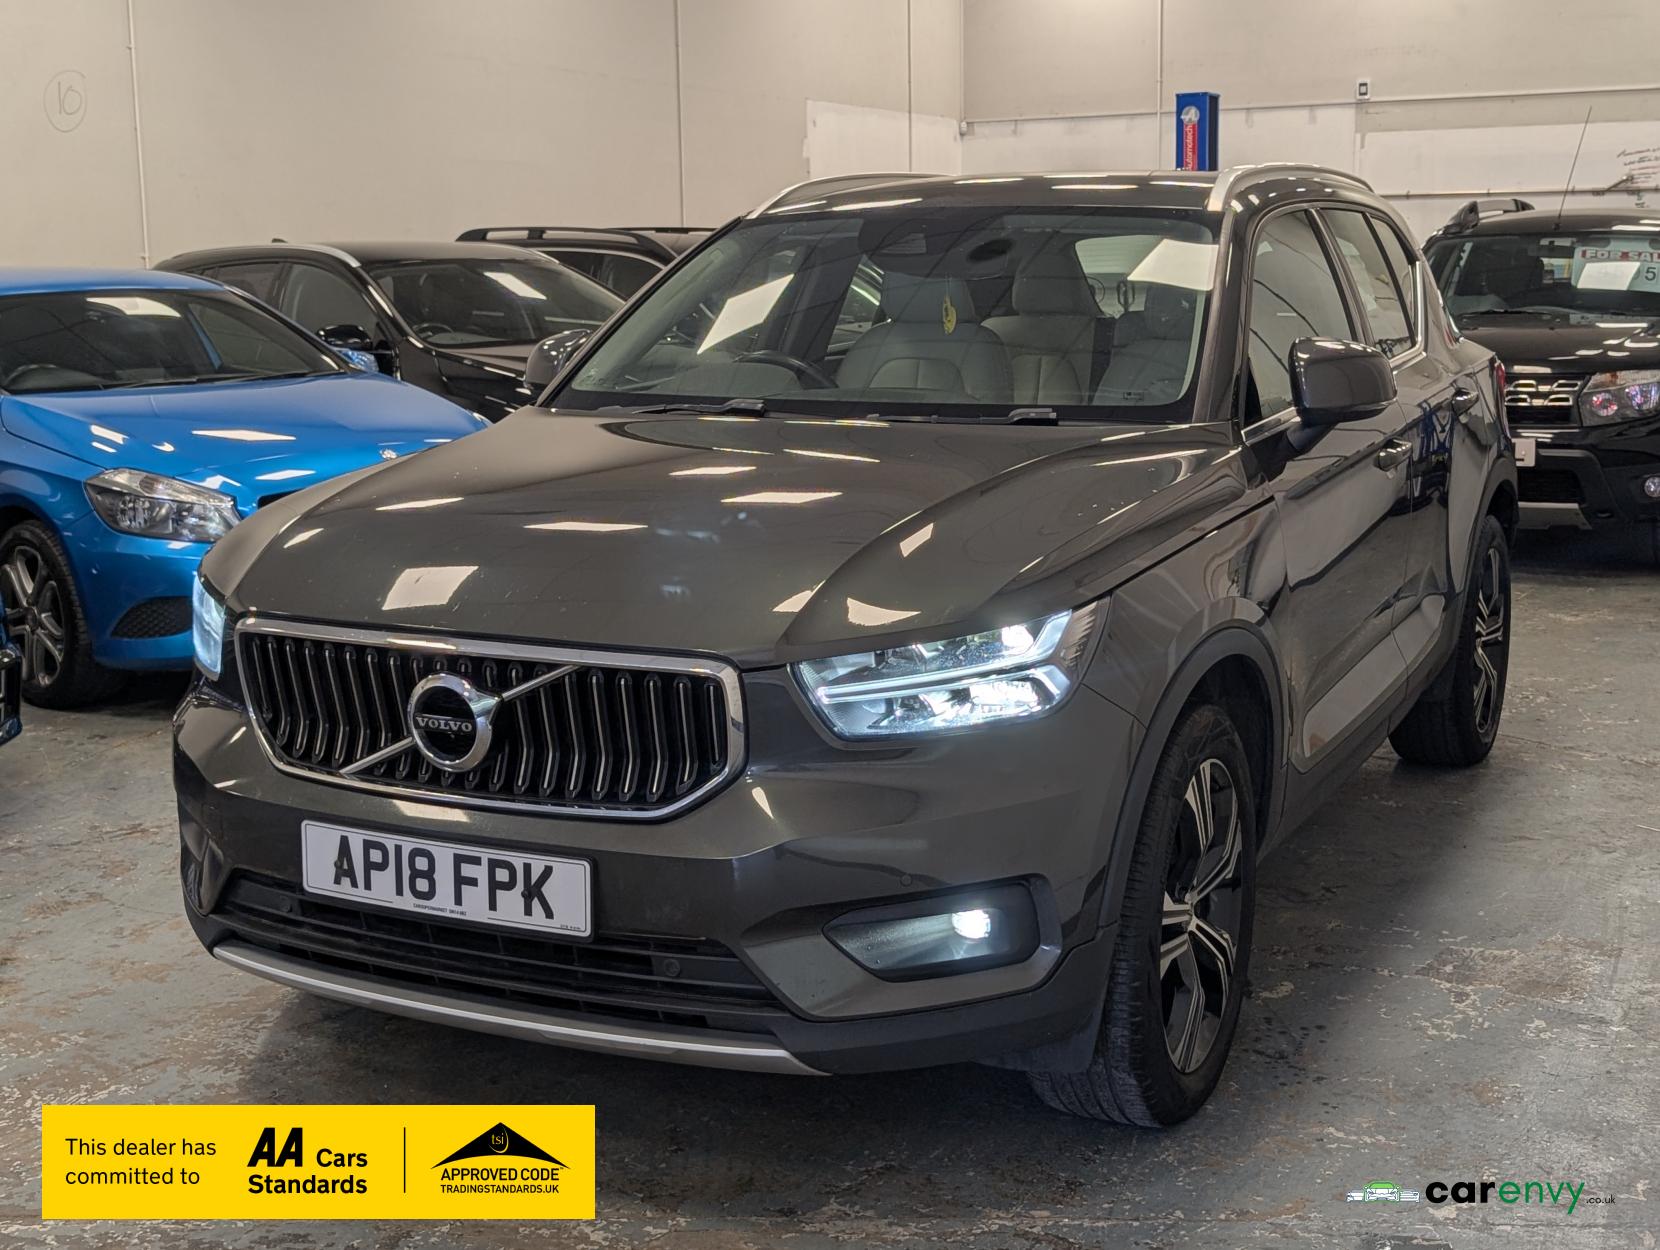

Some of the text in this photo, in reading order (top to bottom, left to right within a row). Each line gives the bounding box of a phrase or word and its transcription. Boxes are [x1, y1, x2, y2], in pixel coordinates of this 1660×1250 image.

[416, 717, 472, 732] VOLVO
[333, 834, 555, 920] AP18 FPK
